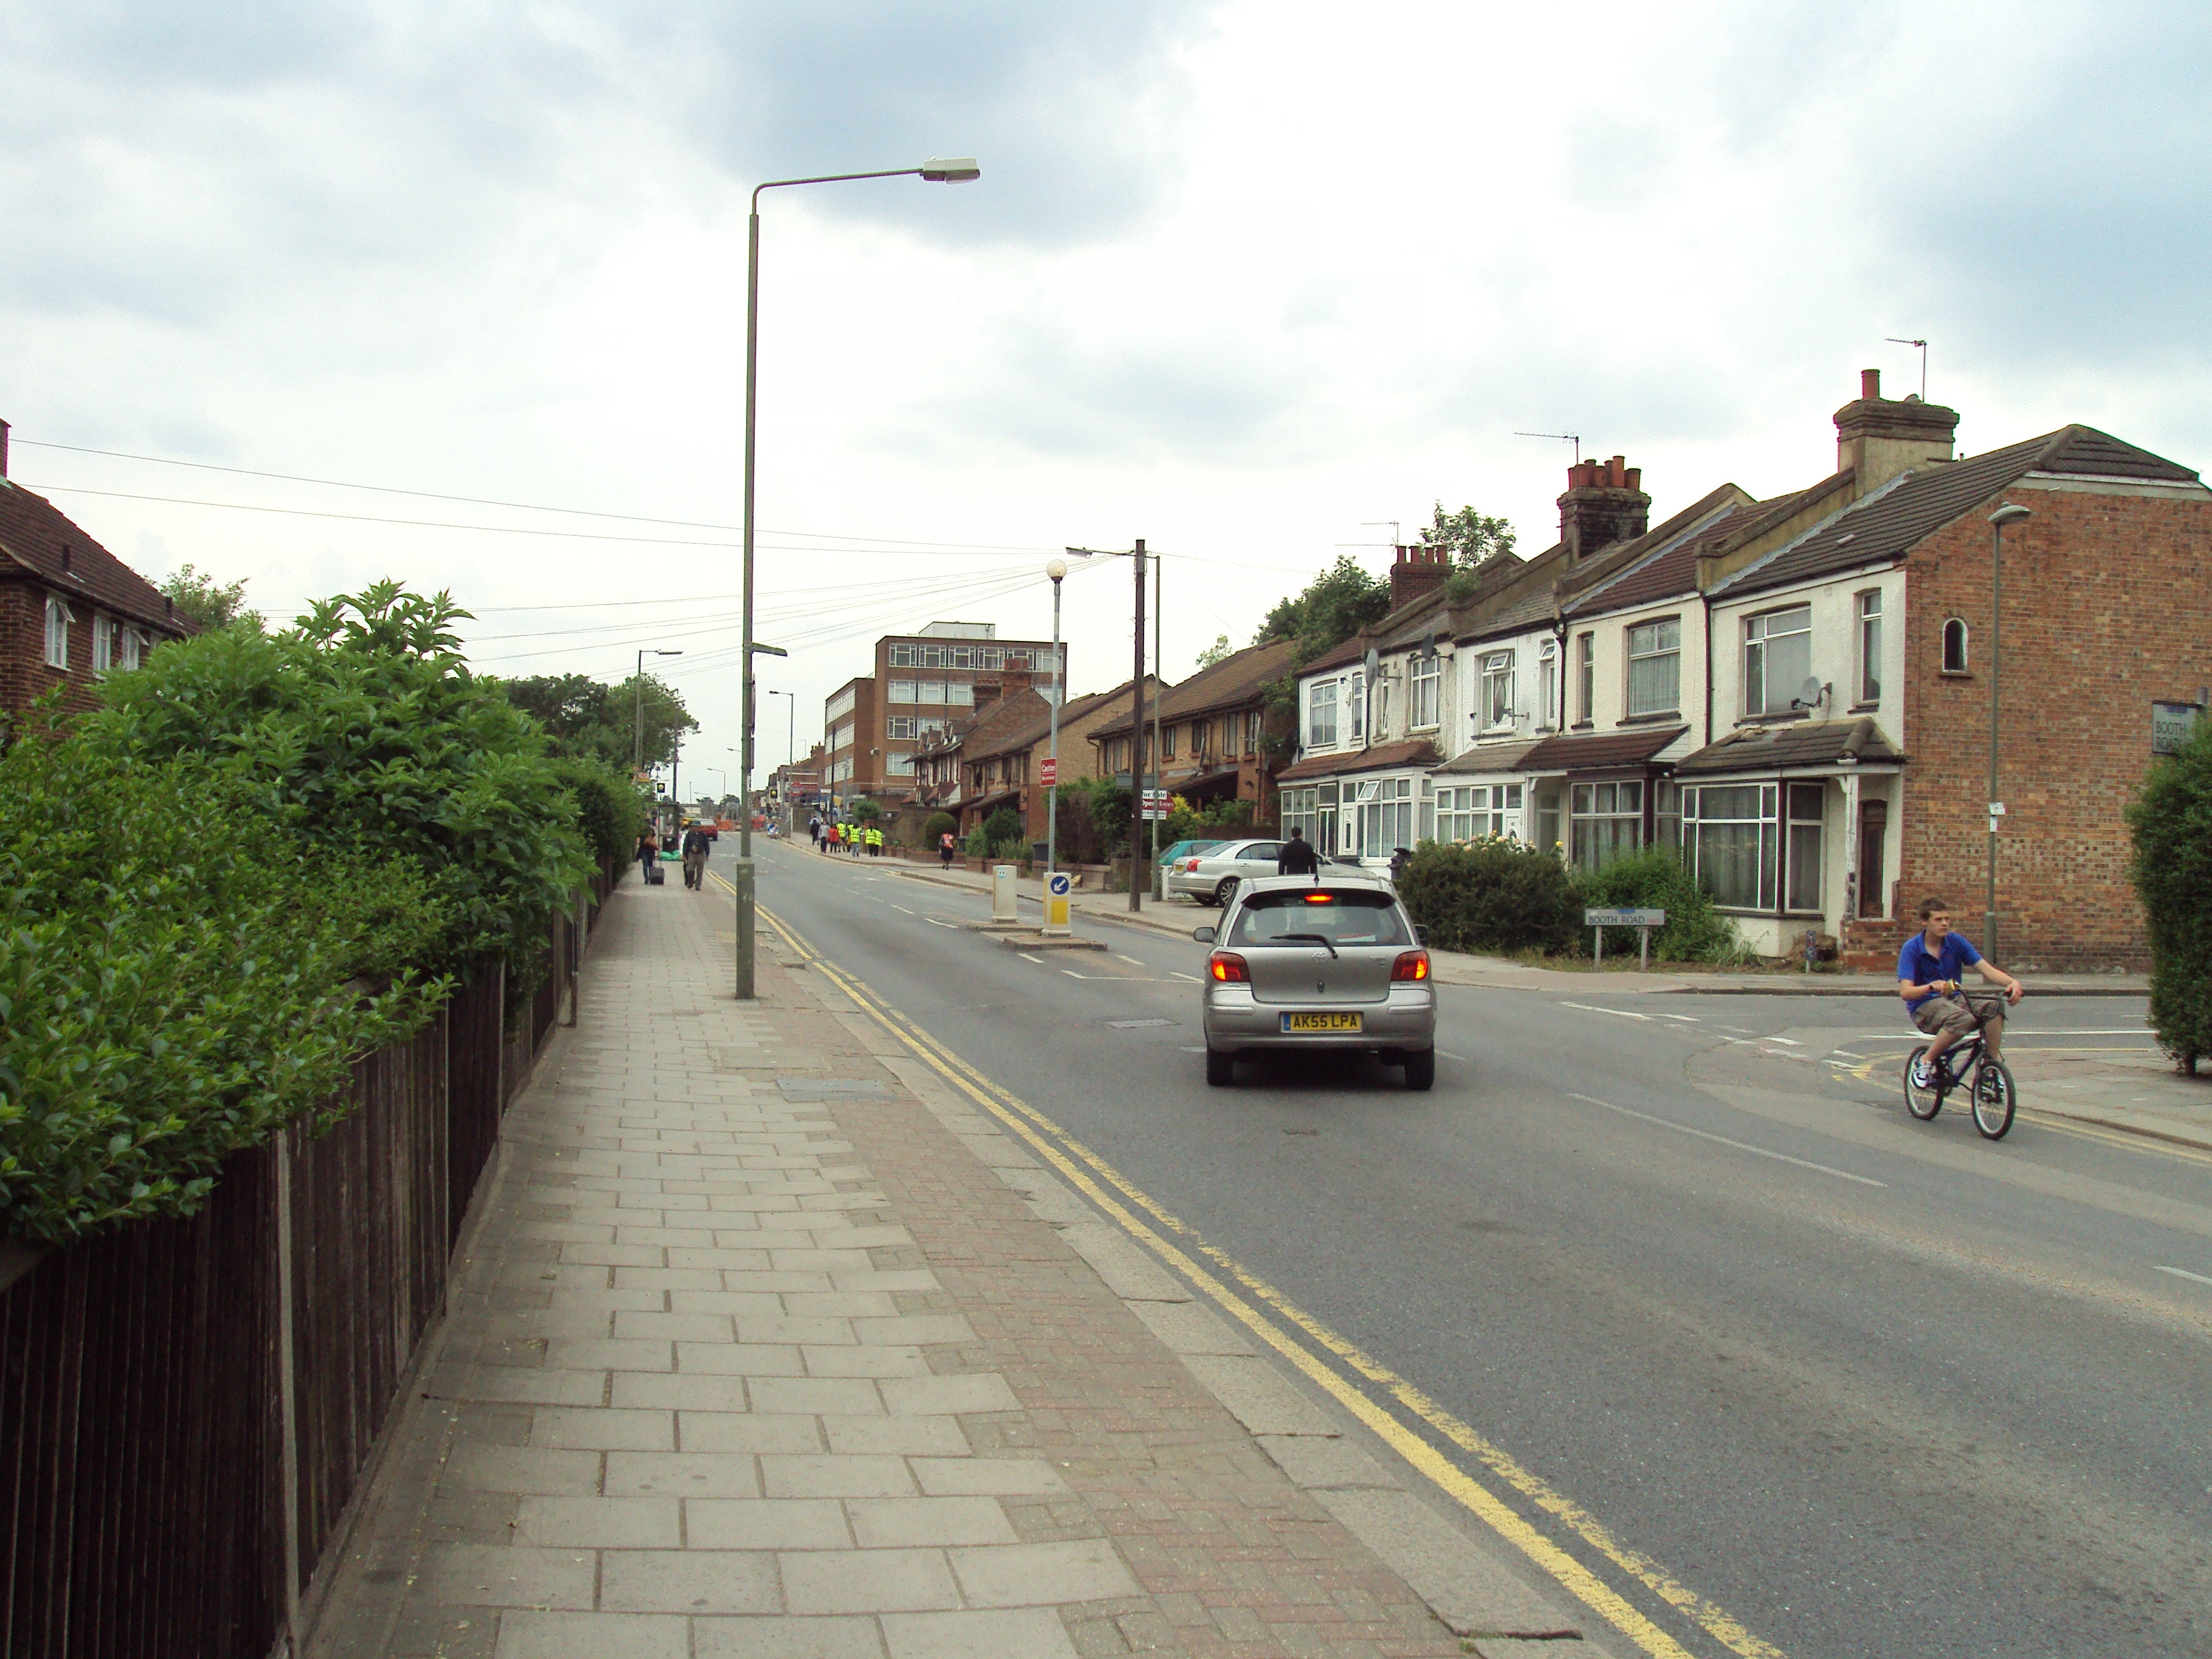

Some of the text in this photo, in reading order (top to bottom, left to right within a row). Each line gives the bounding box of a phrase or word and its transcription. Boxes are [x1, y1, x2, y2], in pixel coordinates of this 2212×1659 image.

[2156, 720, 2186, 735] BOOTH
[1293, 1014, 1357, 1028] AK55 LPA
